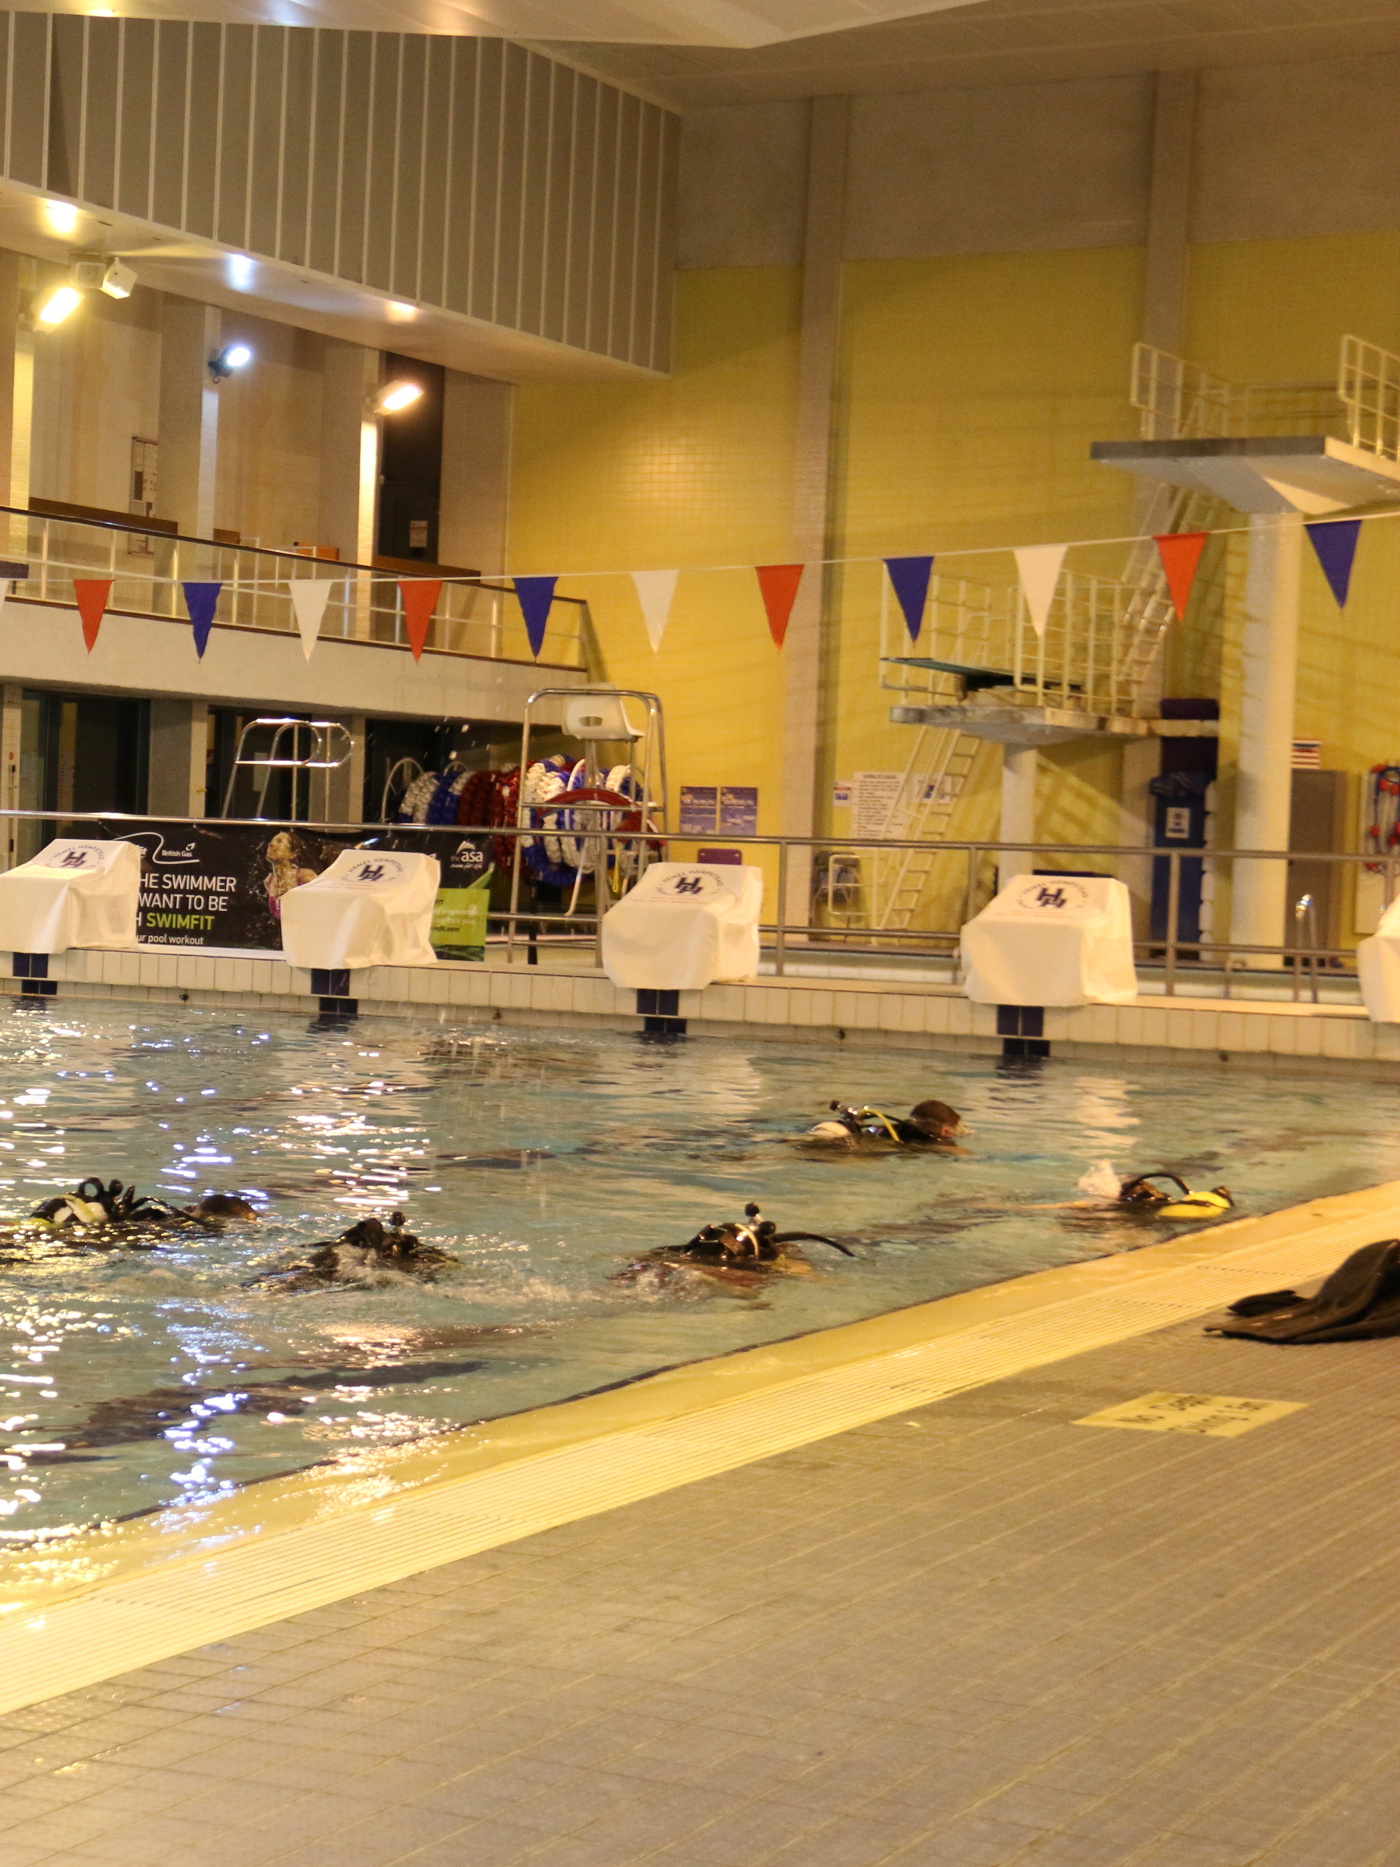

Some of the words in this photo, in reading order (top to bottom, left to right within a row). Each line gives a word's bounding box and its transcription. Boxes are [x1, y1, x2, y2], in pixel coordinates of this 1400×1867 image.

[162, 849, 181, 857] British
[461, 851, 483, 862] asa
[140, 873, 159, 888] HE
[161, 874, 237, 892] SWIMMER
[139, 893, 183, 909] WANT
[186, 895, 204, 910] TO
[208, 896, 229, 912] BE
[146, 912, 215, 931] SWIMFIT
[148, 933, 167, 944] pool
[169, 935, 204, 945] workout
